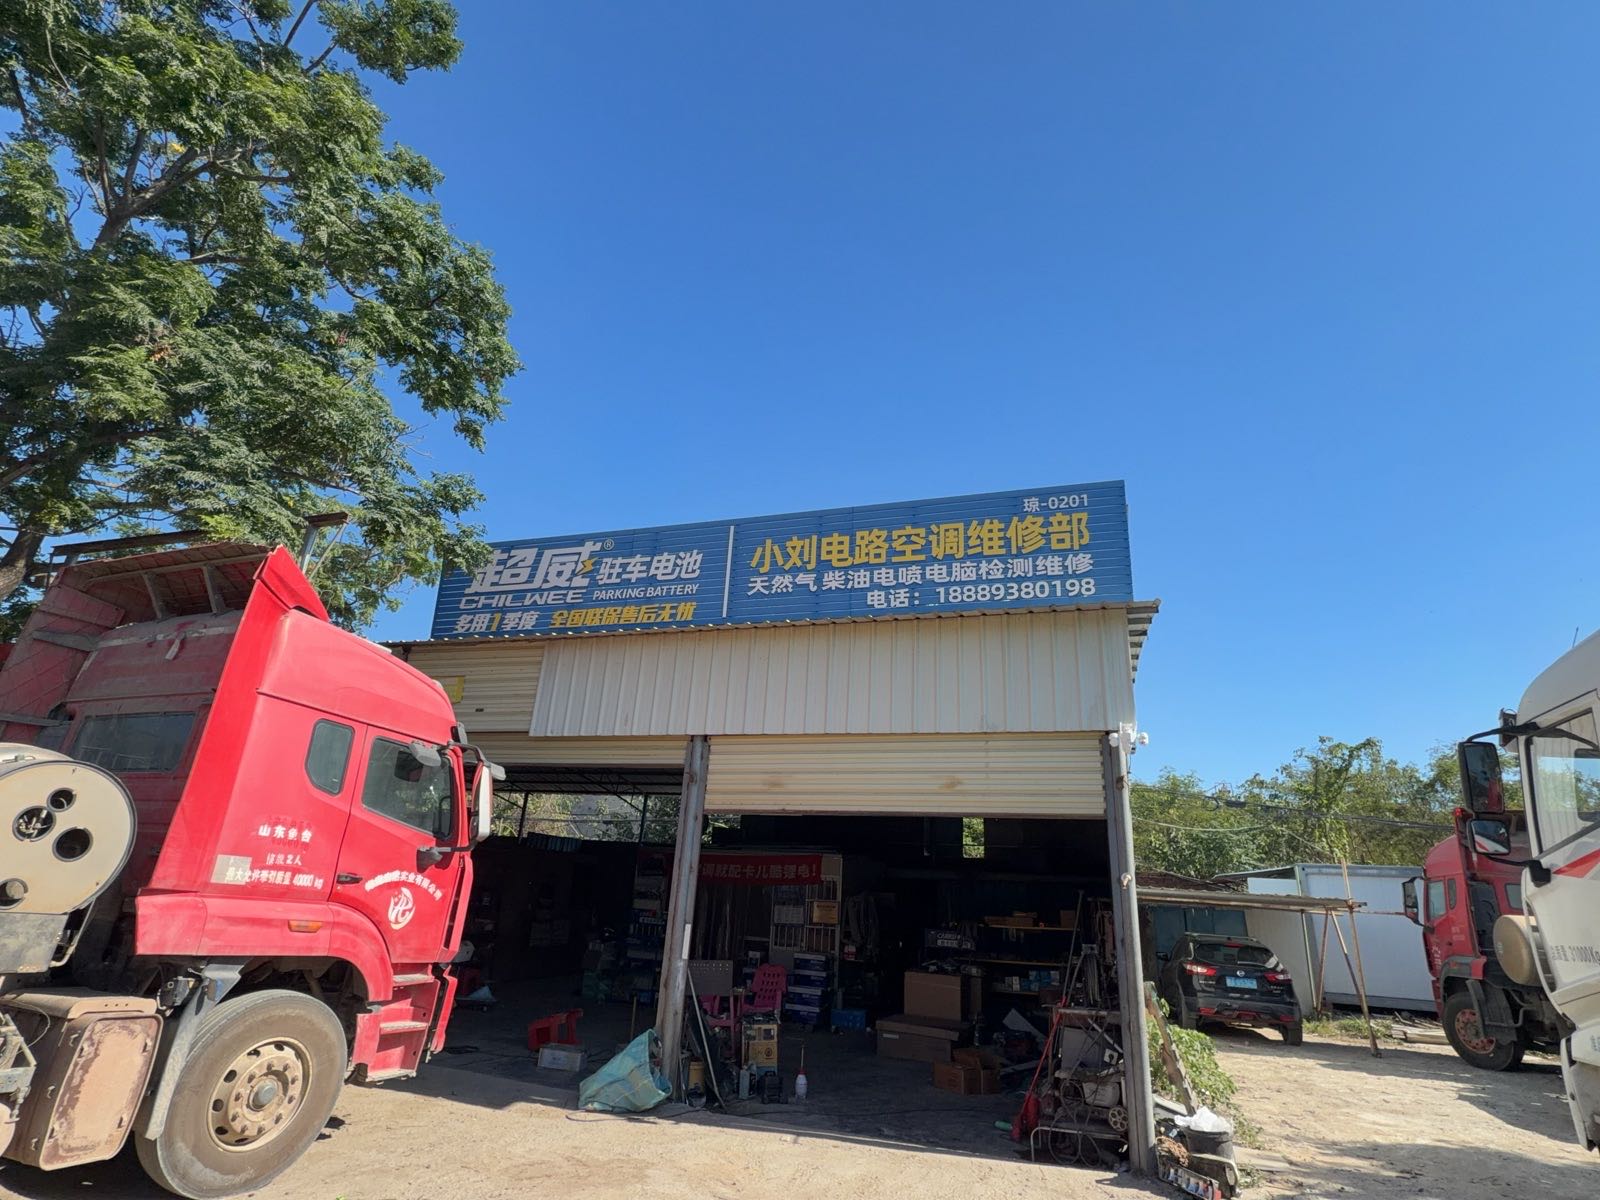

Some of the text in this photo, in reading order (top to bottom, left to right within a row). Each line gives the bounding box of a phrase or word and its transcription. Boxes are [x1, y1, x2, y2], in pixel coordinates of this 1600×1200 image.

[1023, 494, 1089, 513] 琼-0201
[749, 511, 1090, 575] 小刘电路空调维修部
[596, 549, 703, 586] 驻车电池
[459, 589, 587, 610] CHILWEE
[592, 583, 700, 601] PARKING BATTERY
